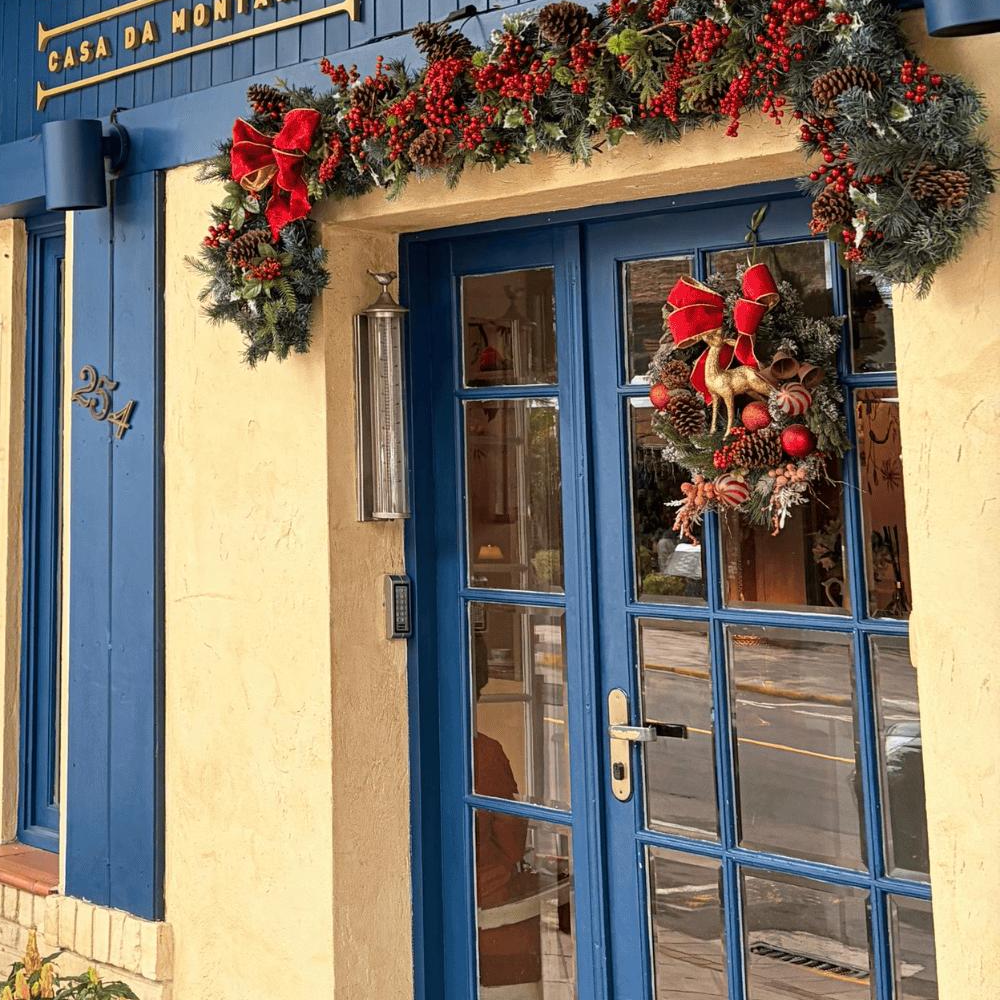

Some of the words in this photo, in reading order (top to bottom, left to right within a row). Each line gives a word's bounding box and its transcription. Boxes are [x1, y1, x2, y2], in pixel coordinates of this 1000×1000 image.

[48, 35, 112, 72] CASA
[124, 20, 160, 50] DA
[71, 364, 137, 440] 254
